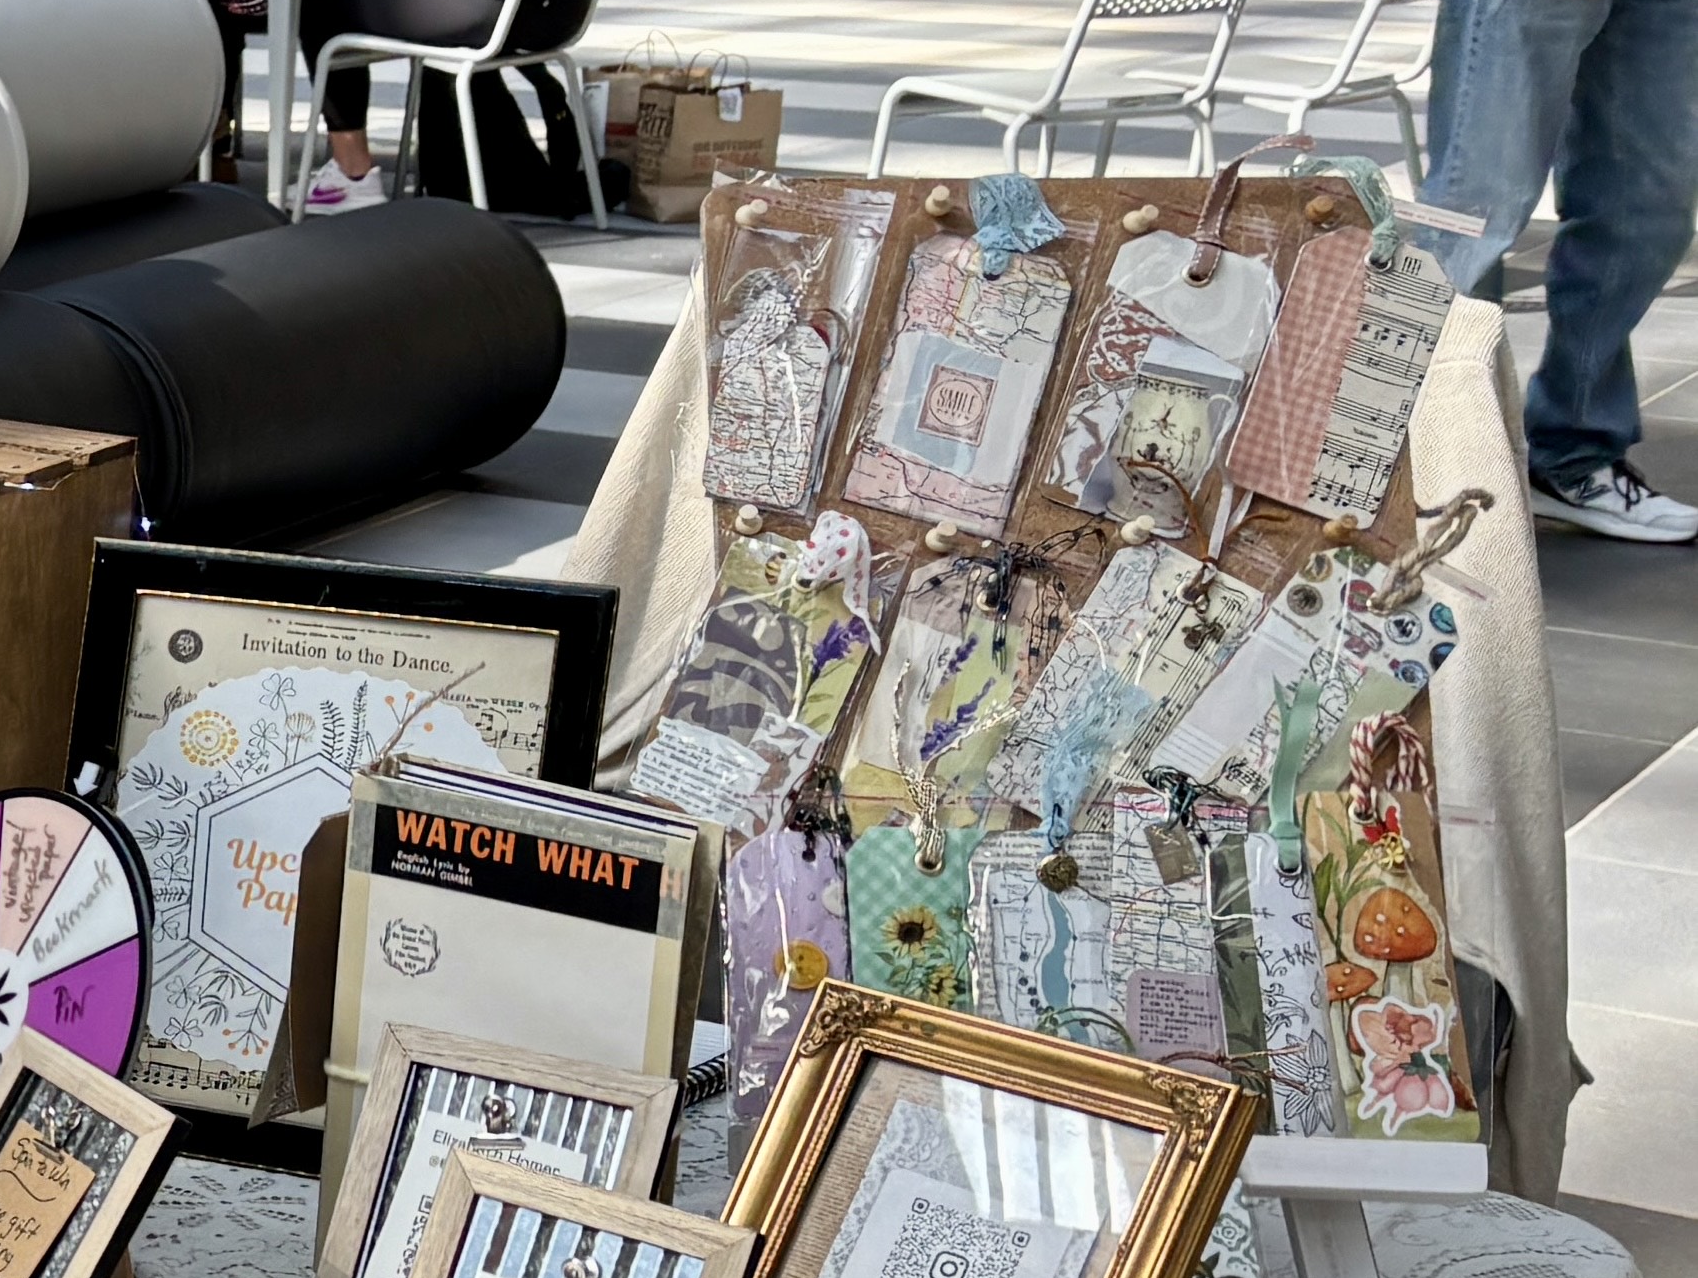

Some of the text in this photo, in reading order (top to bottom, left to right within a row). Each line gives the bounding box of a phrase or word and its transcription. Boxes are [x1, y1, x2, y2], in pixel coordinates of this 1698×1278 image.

[242, 633, 327, 661] Invitation
[336, 642, 354, 663] to
[358, 642, 385, 667] the
[393, 649, 455, 675] Dance.
[396, 809, 516, 865] WATCH
[537, 838, 639, 891] WHAT
[0, 1214, 42, 1242] gift
